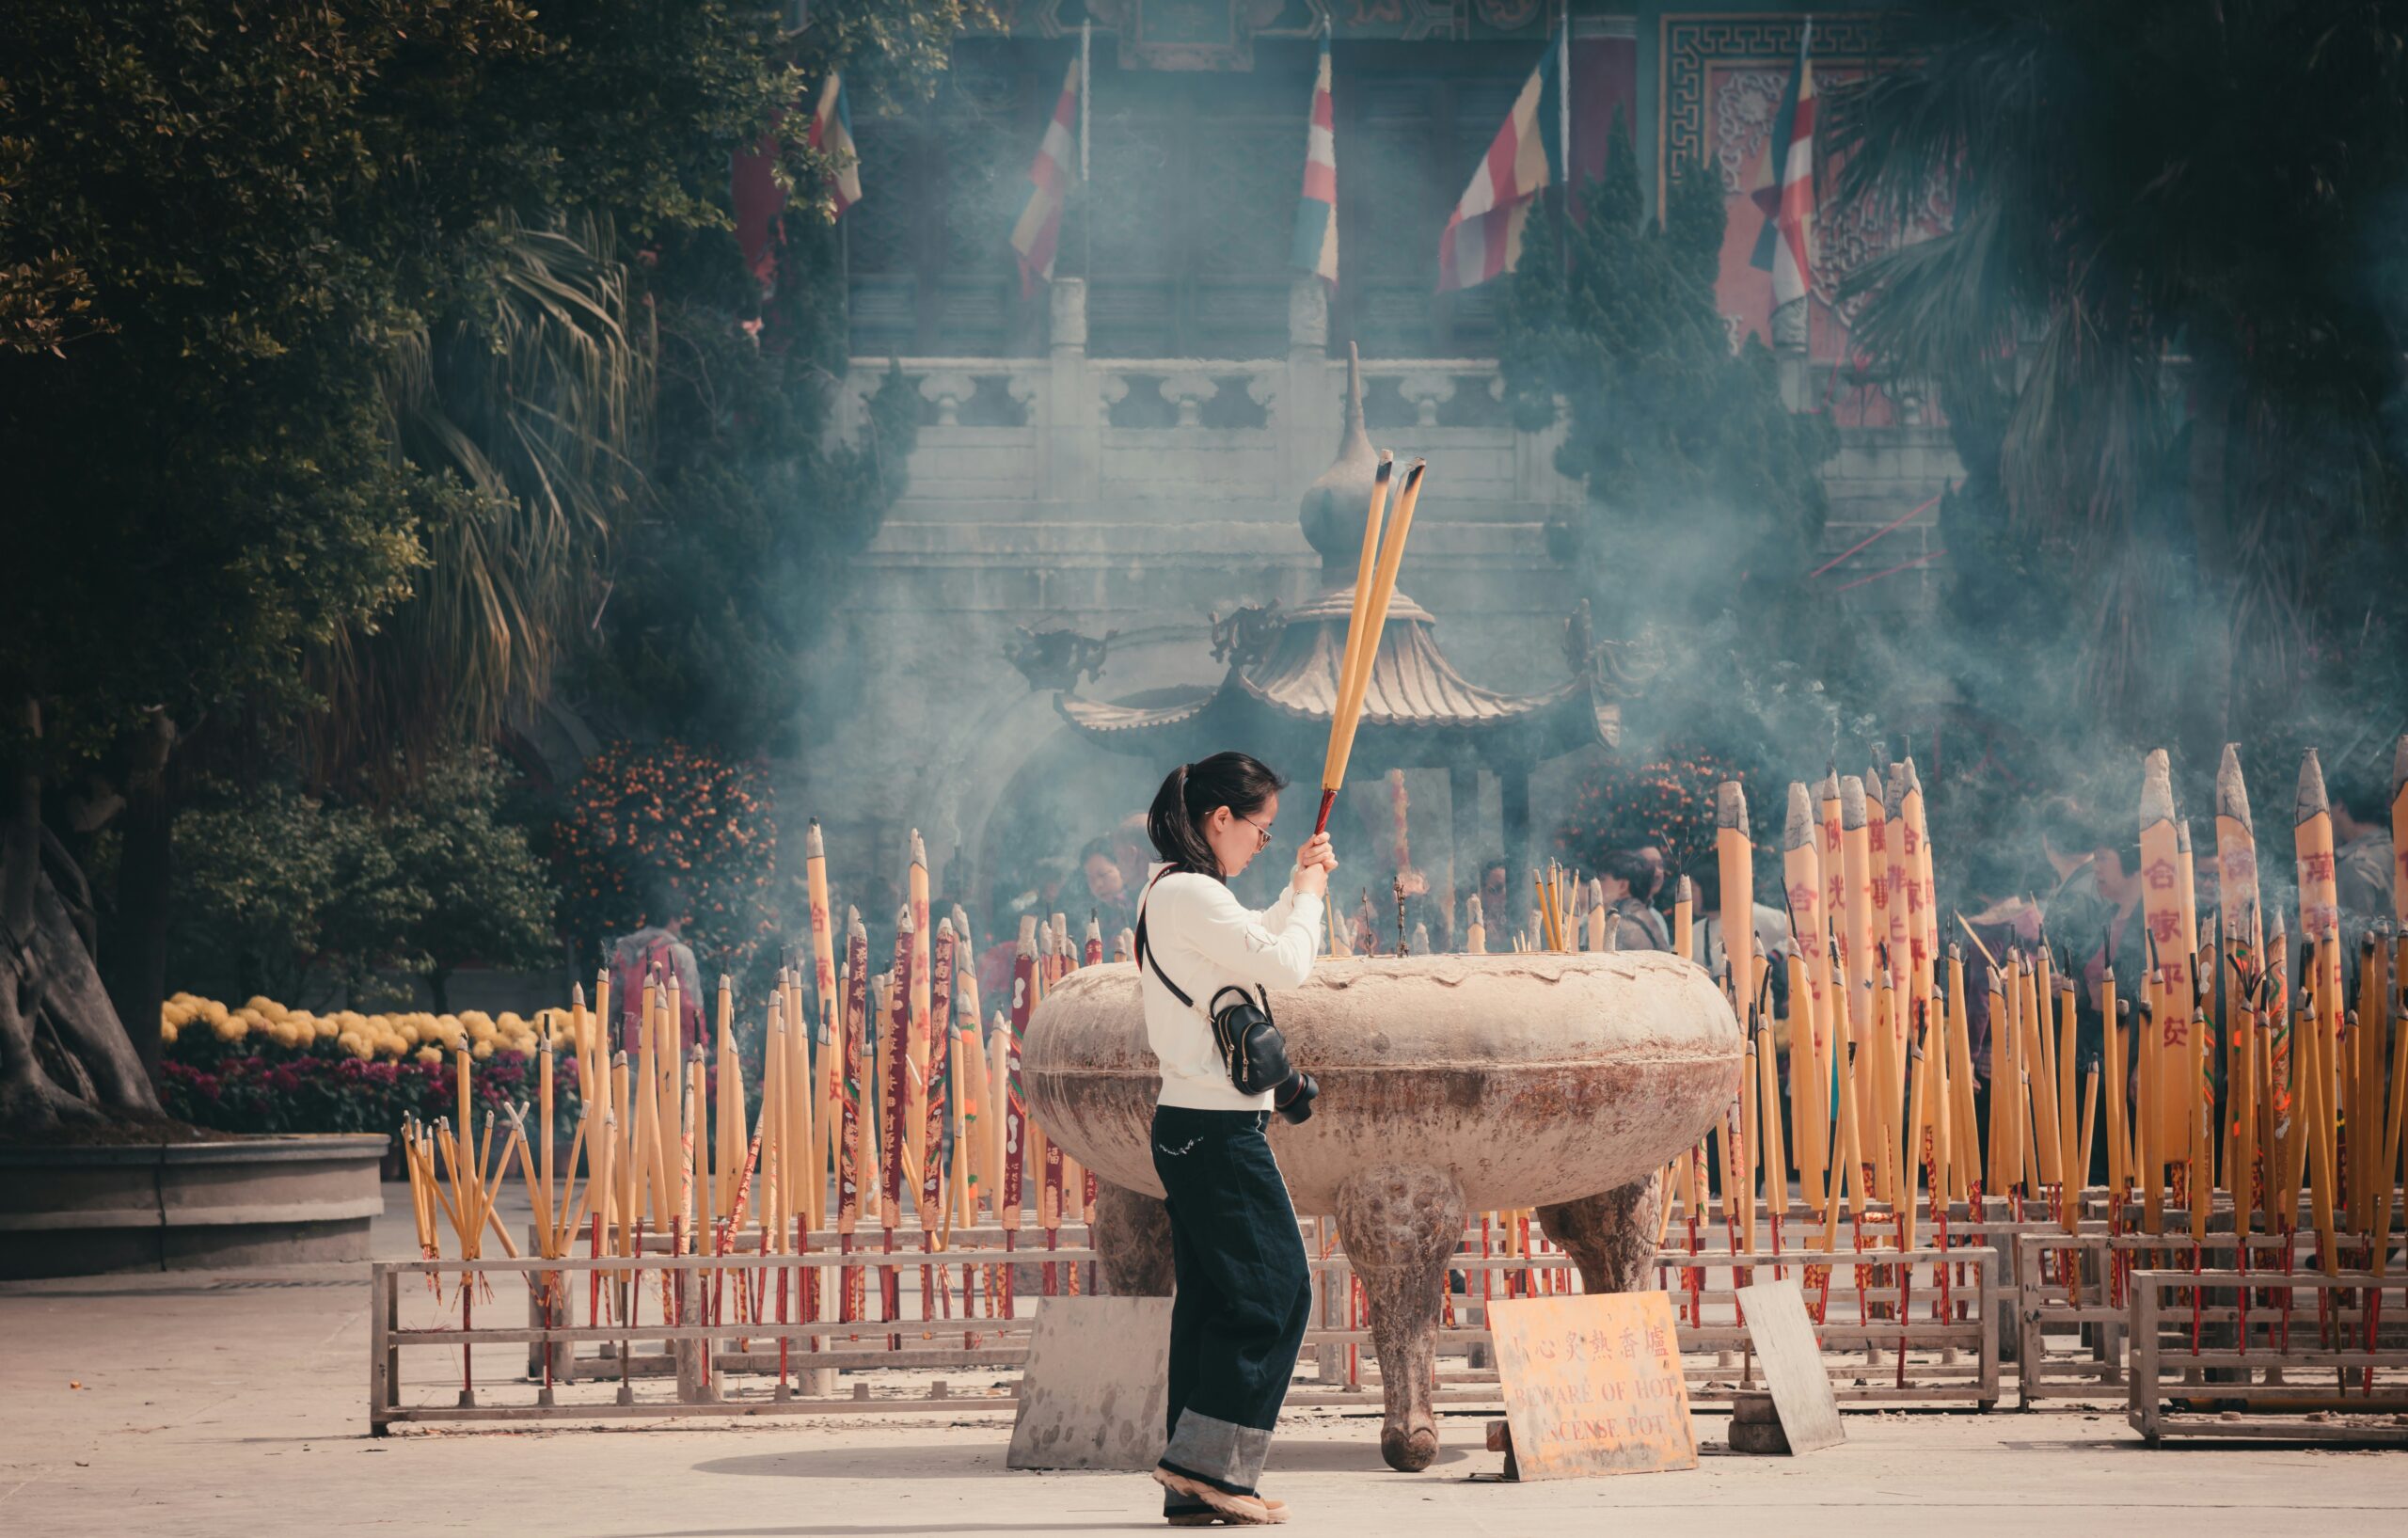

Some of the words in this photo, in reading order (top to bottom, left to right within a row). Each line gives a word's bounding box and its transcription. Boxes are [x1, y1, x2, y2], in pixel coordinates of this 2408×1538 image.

[2144, 858, 2188, 1047] 合家平安
[1514, 1384, 1593, 1408] BEWARE
[1602, 1381, 1625, 1402] OF
[1635, 1378, 1675, 1400] HOT
[1542, 1419, 1616, 1442] NCENSE
[1627, 1416, 1663, 1436] POT
